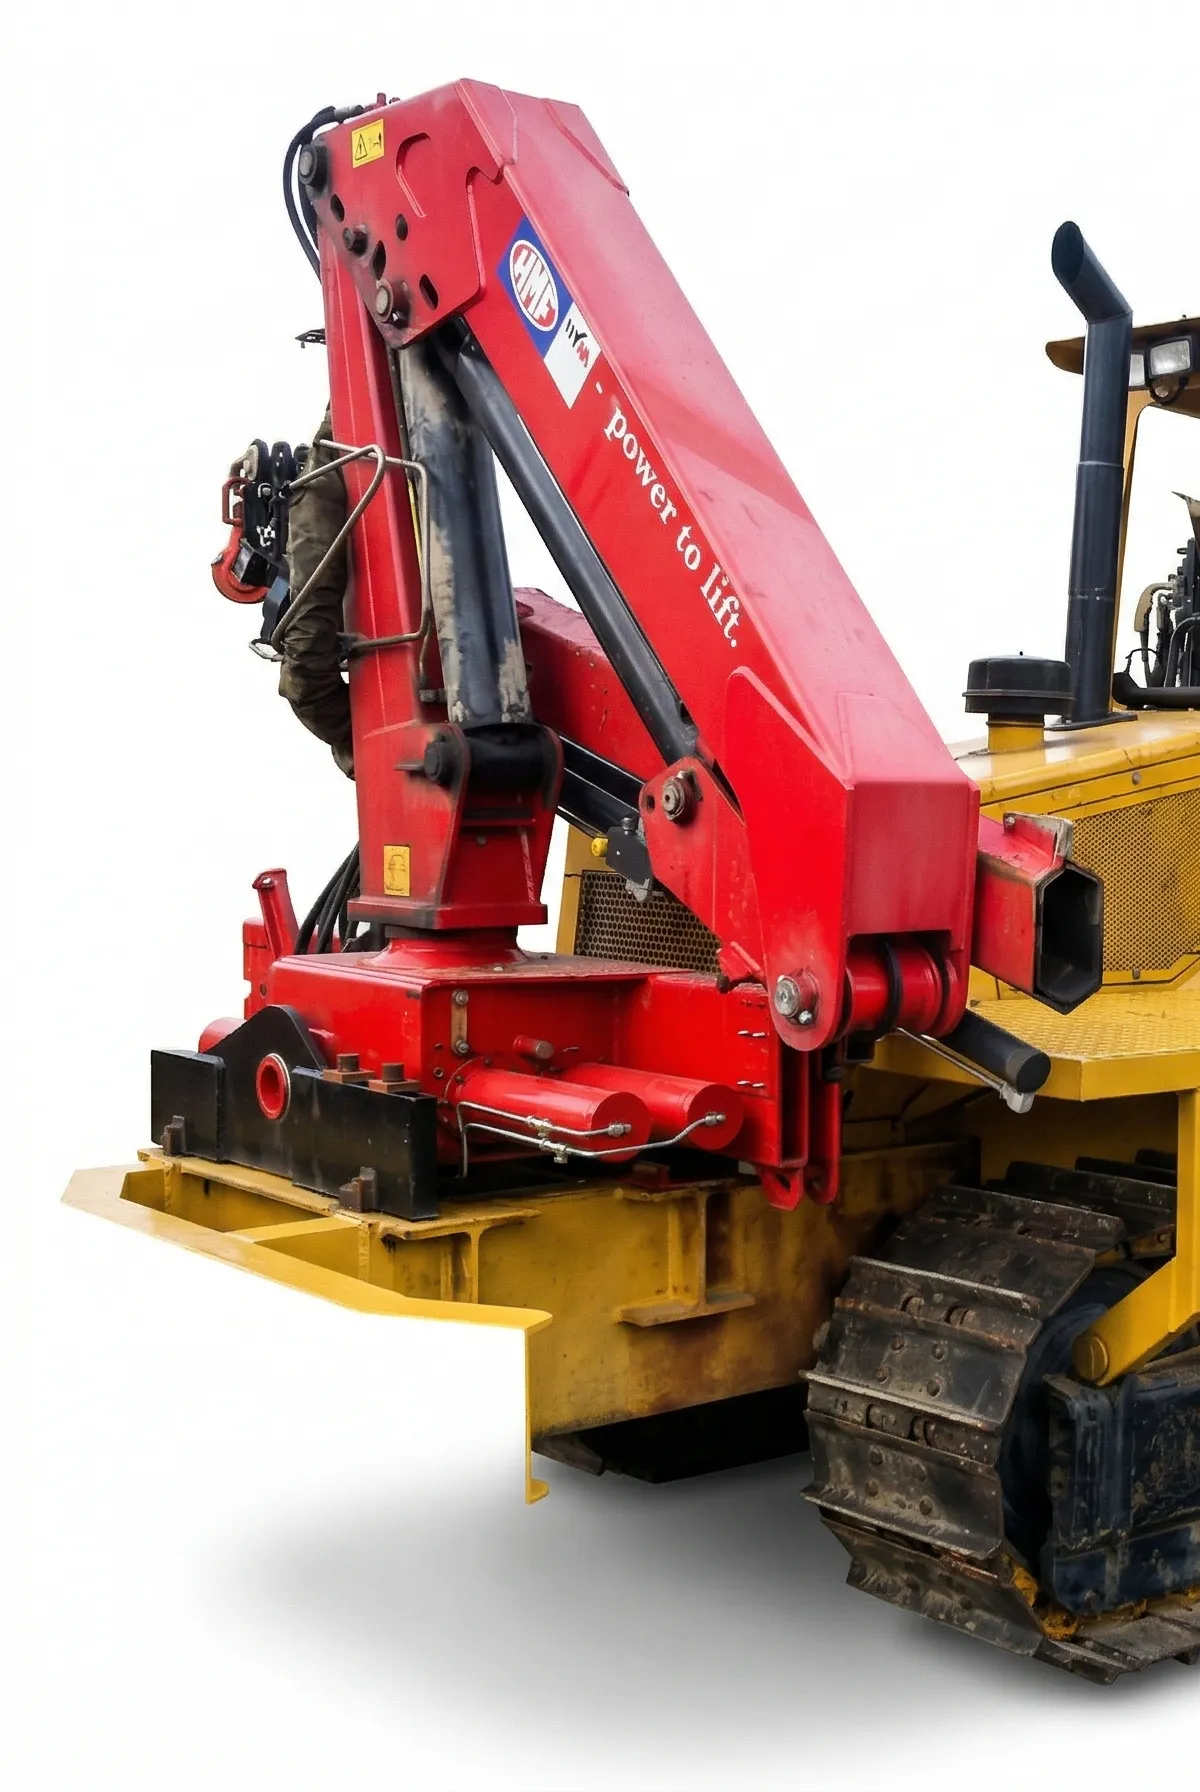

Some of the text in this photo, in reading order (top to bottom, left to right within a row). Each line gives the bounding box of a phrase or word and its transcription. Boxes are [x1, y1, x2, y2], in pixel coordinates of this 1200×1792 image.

[512, 248, 556, 321] HMF
[603, 406, 677, 525] power
[676, 525, 701, 571] to
